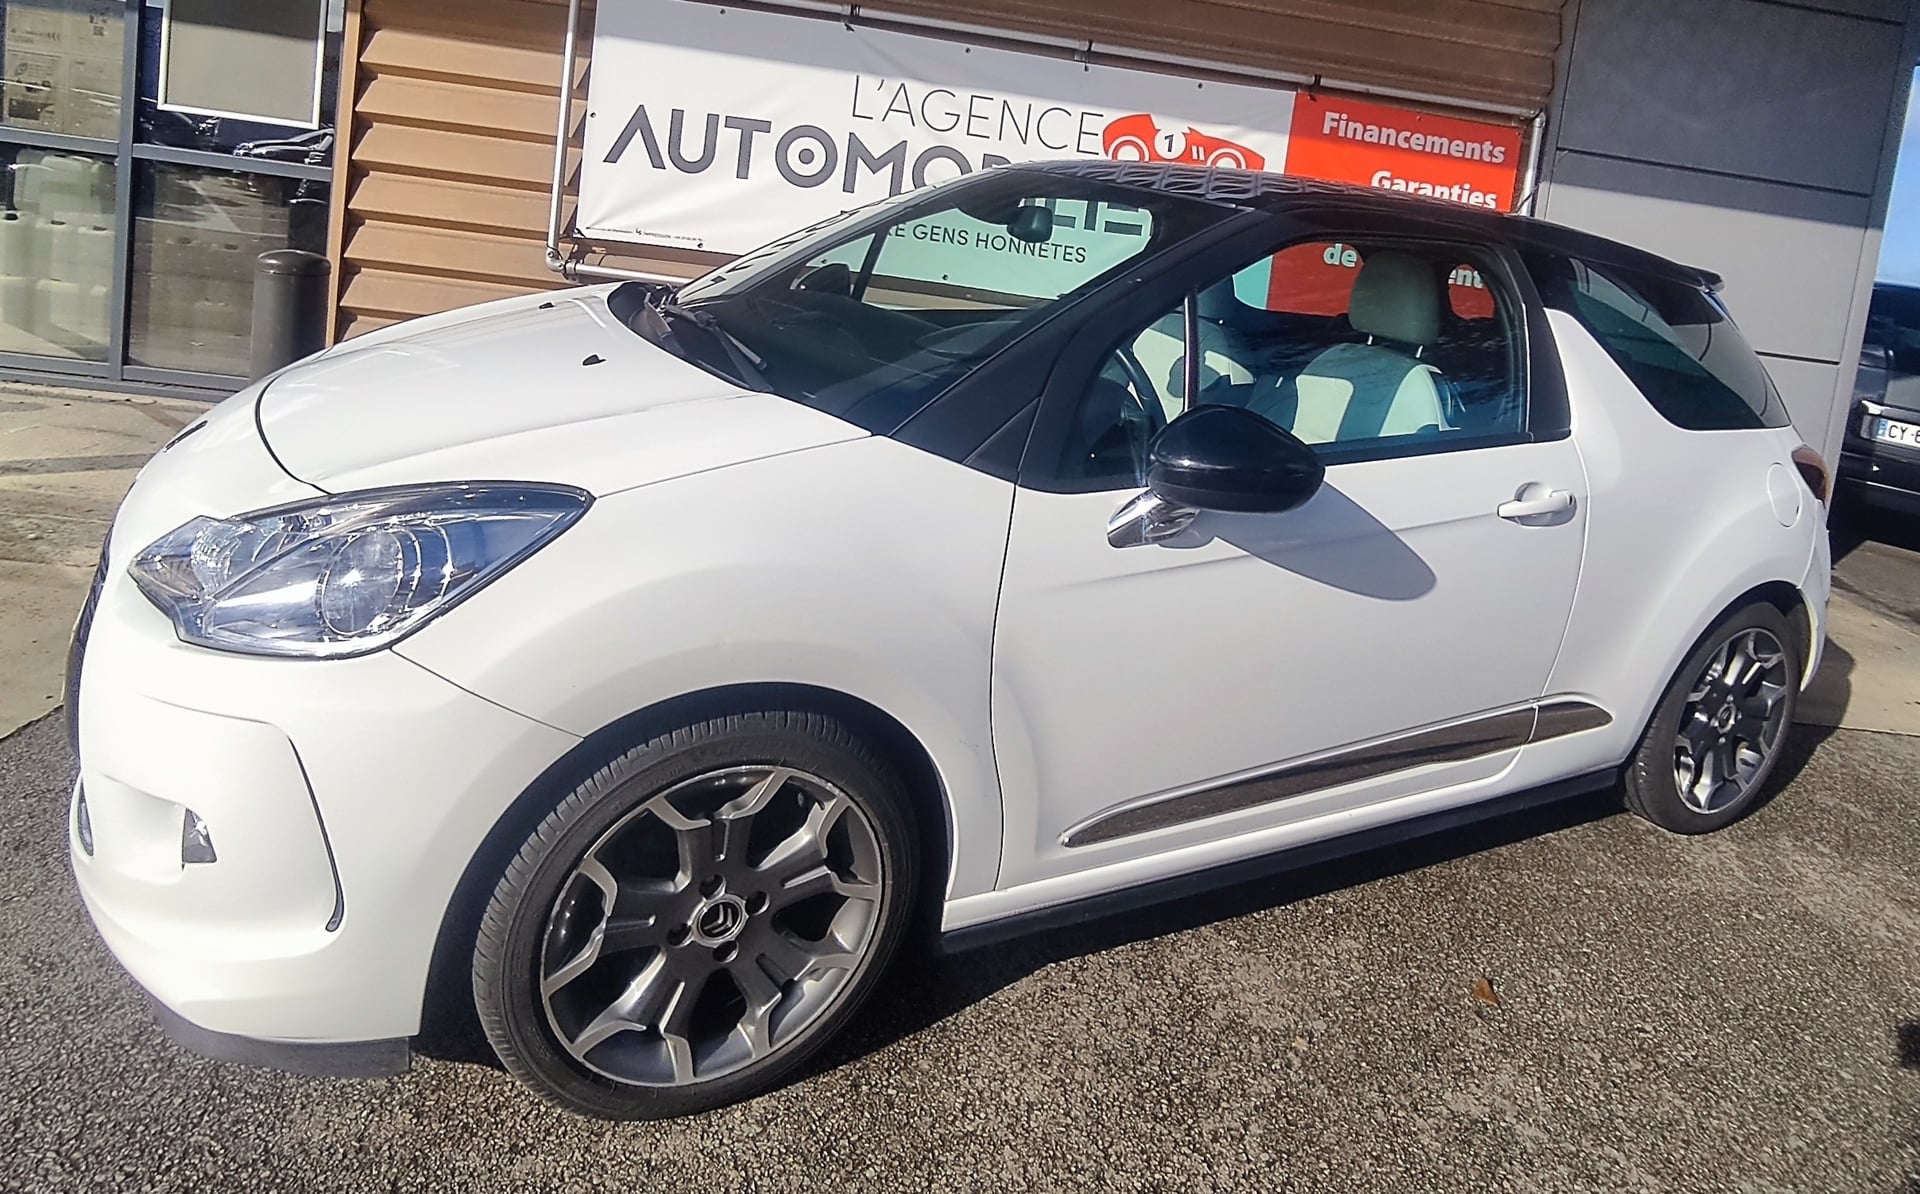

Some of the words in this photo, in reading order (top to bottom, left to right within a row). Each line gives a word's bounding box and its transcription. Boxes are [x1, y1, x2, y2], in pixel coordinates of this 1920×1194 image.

[851, 74, 1104, 156] L'AGENCE
[1322, 111, 1506, 164] Financements
[602, 104, 1011, 198] AUTOMO
[1371, 170, 1497, 209] Garanties
[912, 223, 969, 246] GENS
[1323, 243, 1357, 268] de
